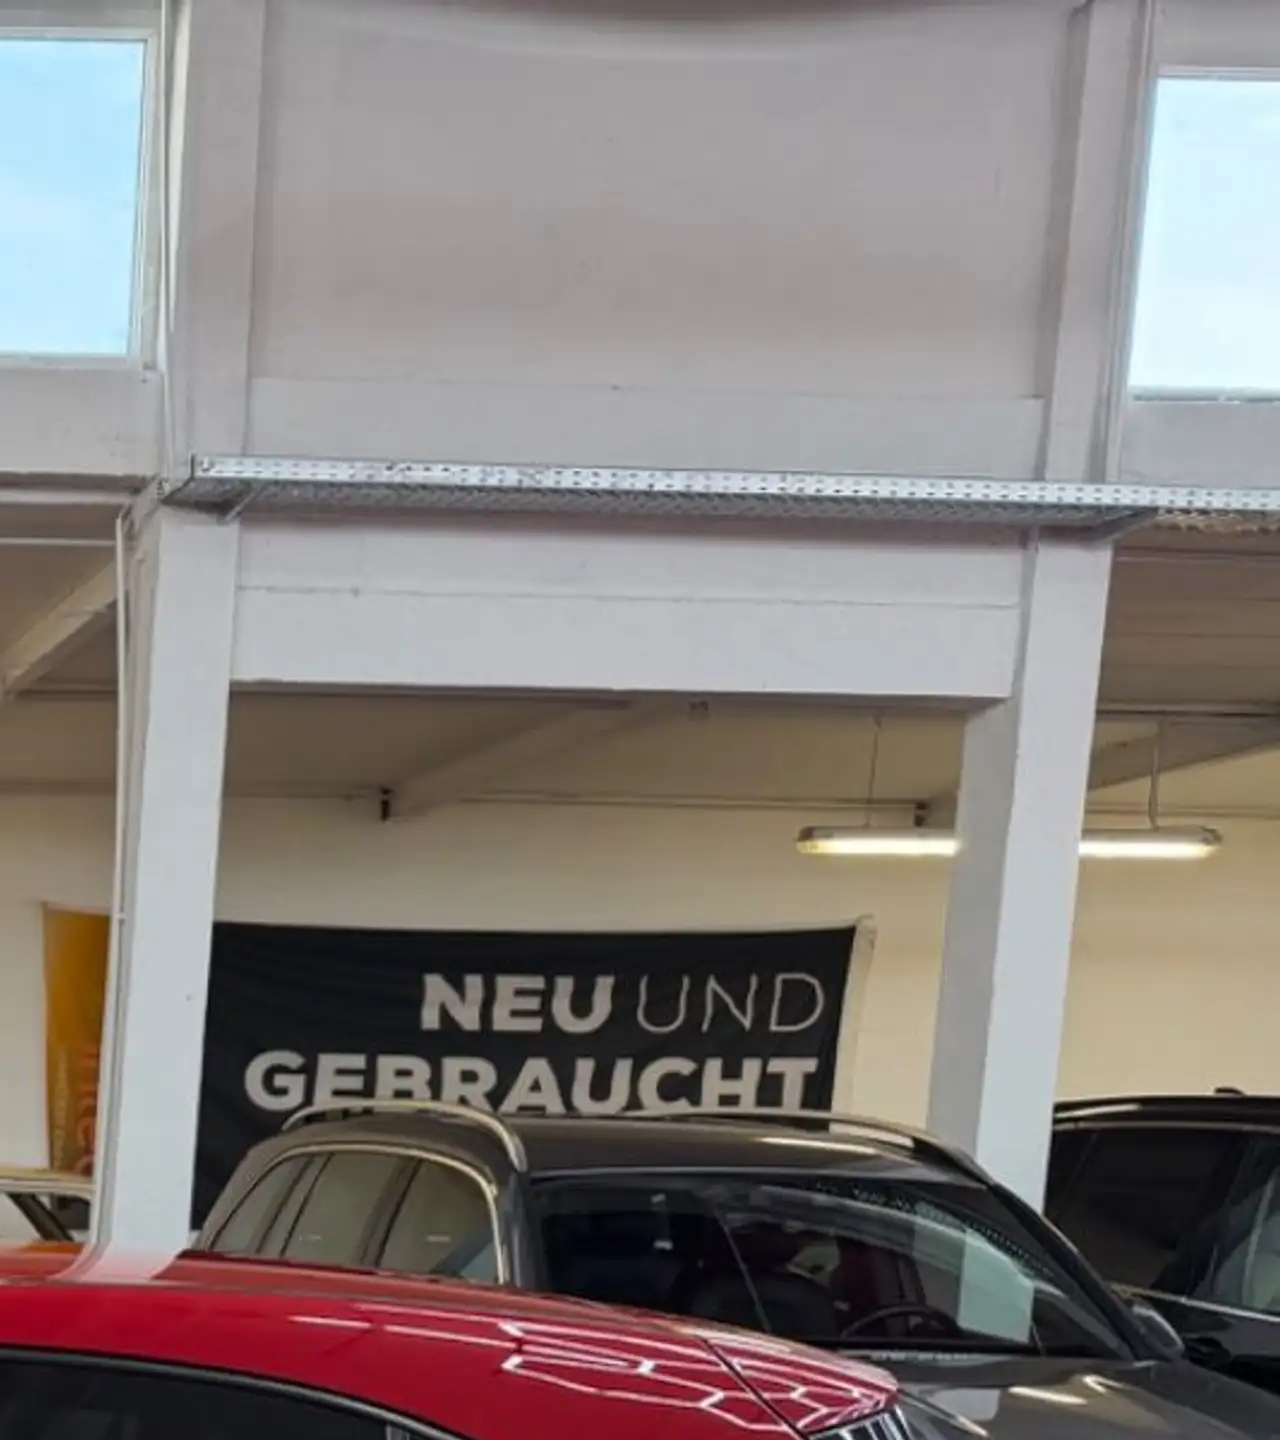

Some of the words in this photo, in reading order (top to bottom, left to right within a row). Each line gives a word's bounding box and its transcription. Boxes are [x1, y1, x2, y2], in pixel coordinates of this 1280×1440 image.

[421, 974, 614, 1033] NEU
[636, 974, 824, 1033] UND
[244, 1050, 819, 1116] GEBRAUCHT
